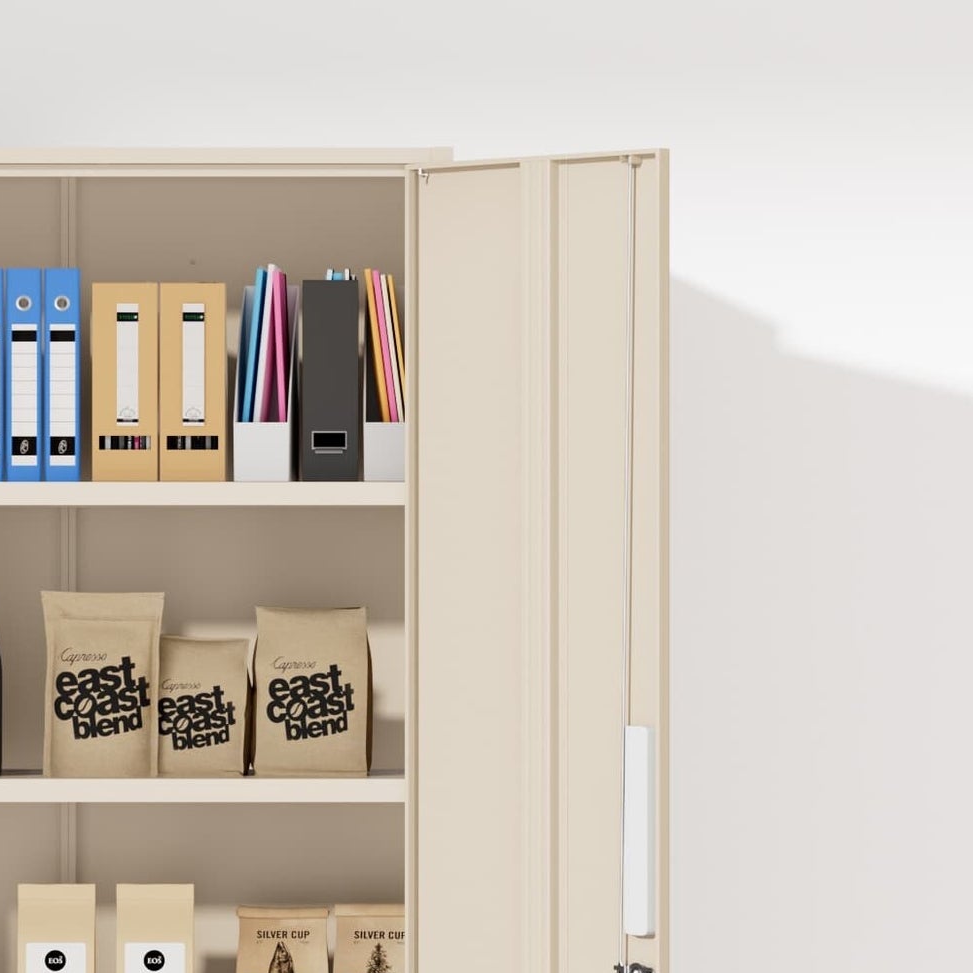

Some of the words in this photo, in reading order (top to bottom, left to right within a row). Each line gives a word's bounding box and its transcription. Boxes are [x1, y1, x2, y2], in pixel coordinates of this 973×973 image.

[60, 647, 108, 666] Capresso
[271, 656, 317, 674] Capresso
[55, 656, 136, 697] east
[161, 679, 202, 693] Capresso
[268, 664, 342, 701] east
[54, 676, 151, 721] coast
[158, 685, 225, 718] east
[266, 683, 355, 723] coast
[72, 705, 143, 740] blend
[158, 701, 236, 735] coast
[285, 710, 348, 741] blend
[171, 724, 230, 751] blend
[256, 930, 288, 939] SILVER
[291, 930, 310, 939] CUP
[354, 931, 385, 940] SILVER
